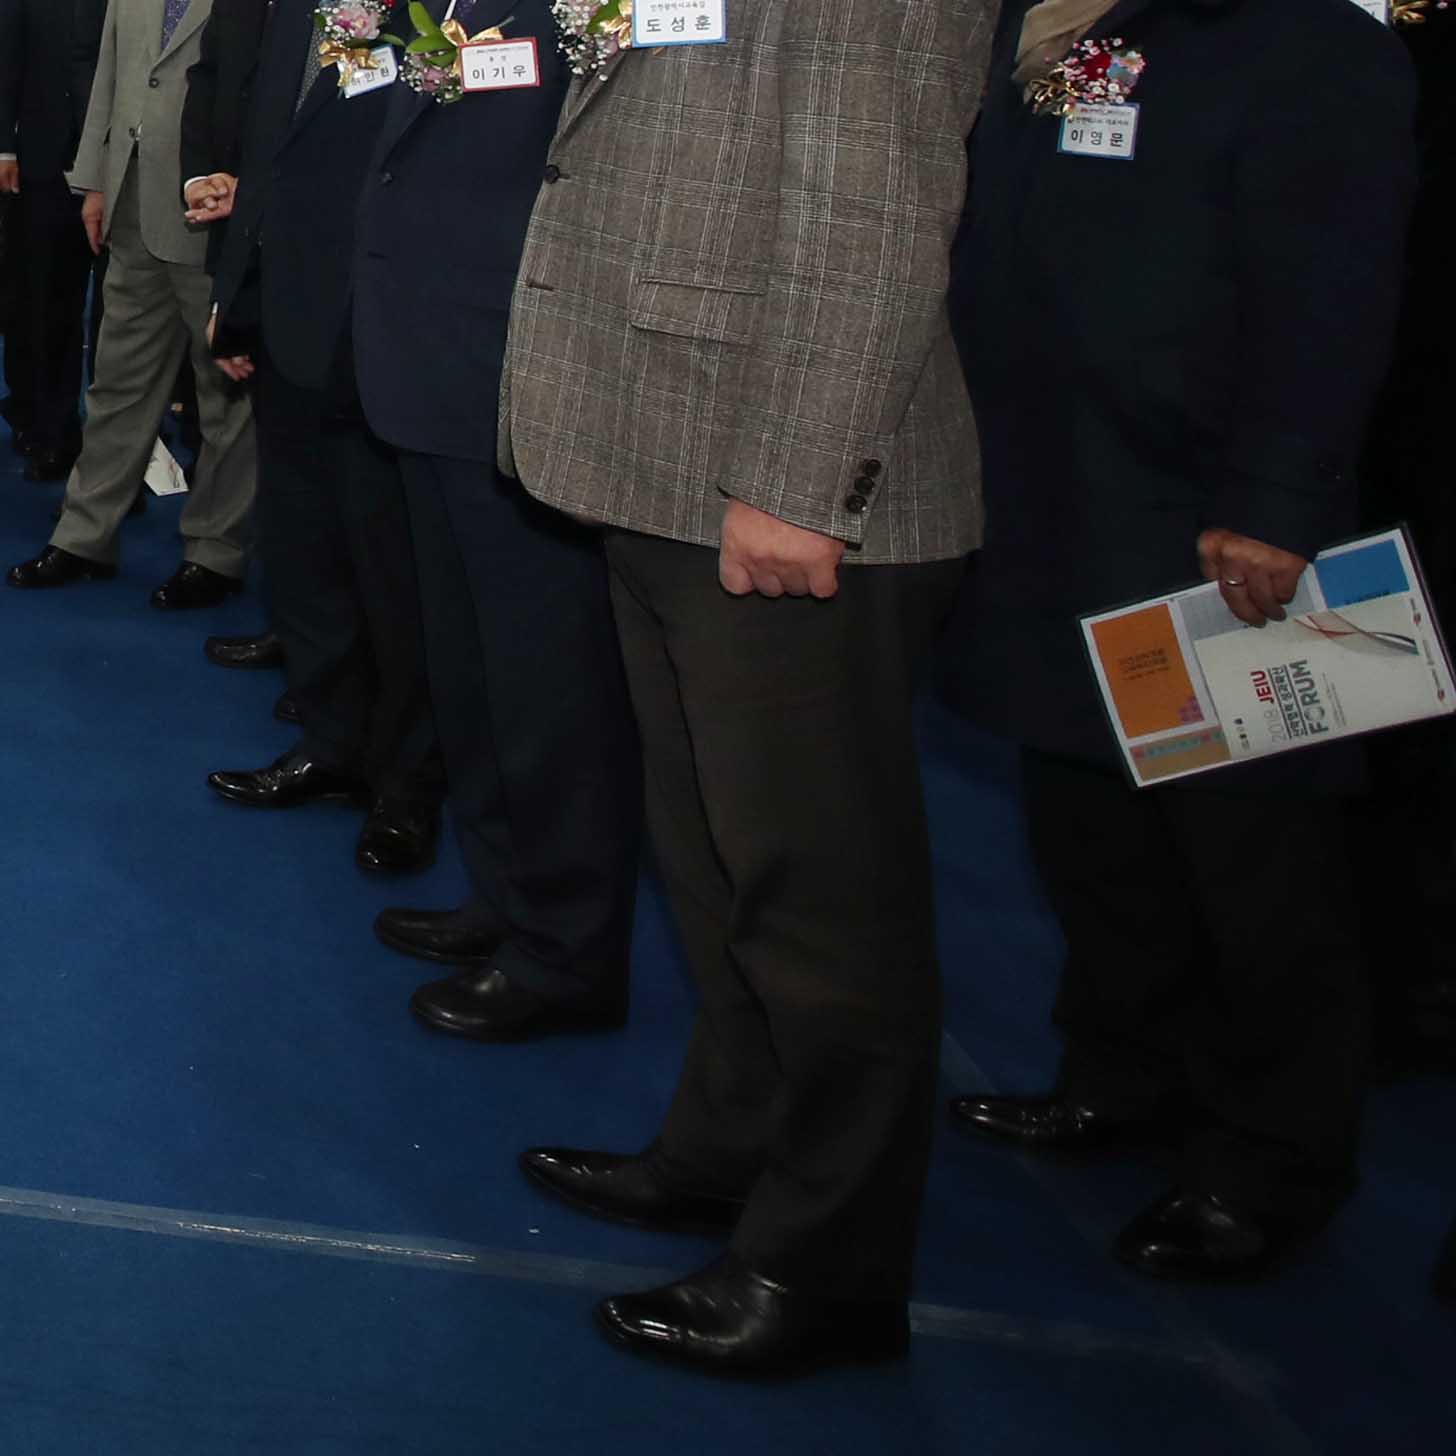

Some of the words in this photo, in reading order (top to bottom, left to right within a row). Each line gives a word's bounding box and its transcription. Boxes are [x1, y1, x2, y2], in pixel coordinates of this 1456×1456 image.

[472, 65, 528, 81] 이기우
[1249, 670, 1275, 704] JEIU
[1288, 659, 1329, 736] FORUM
